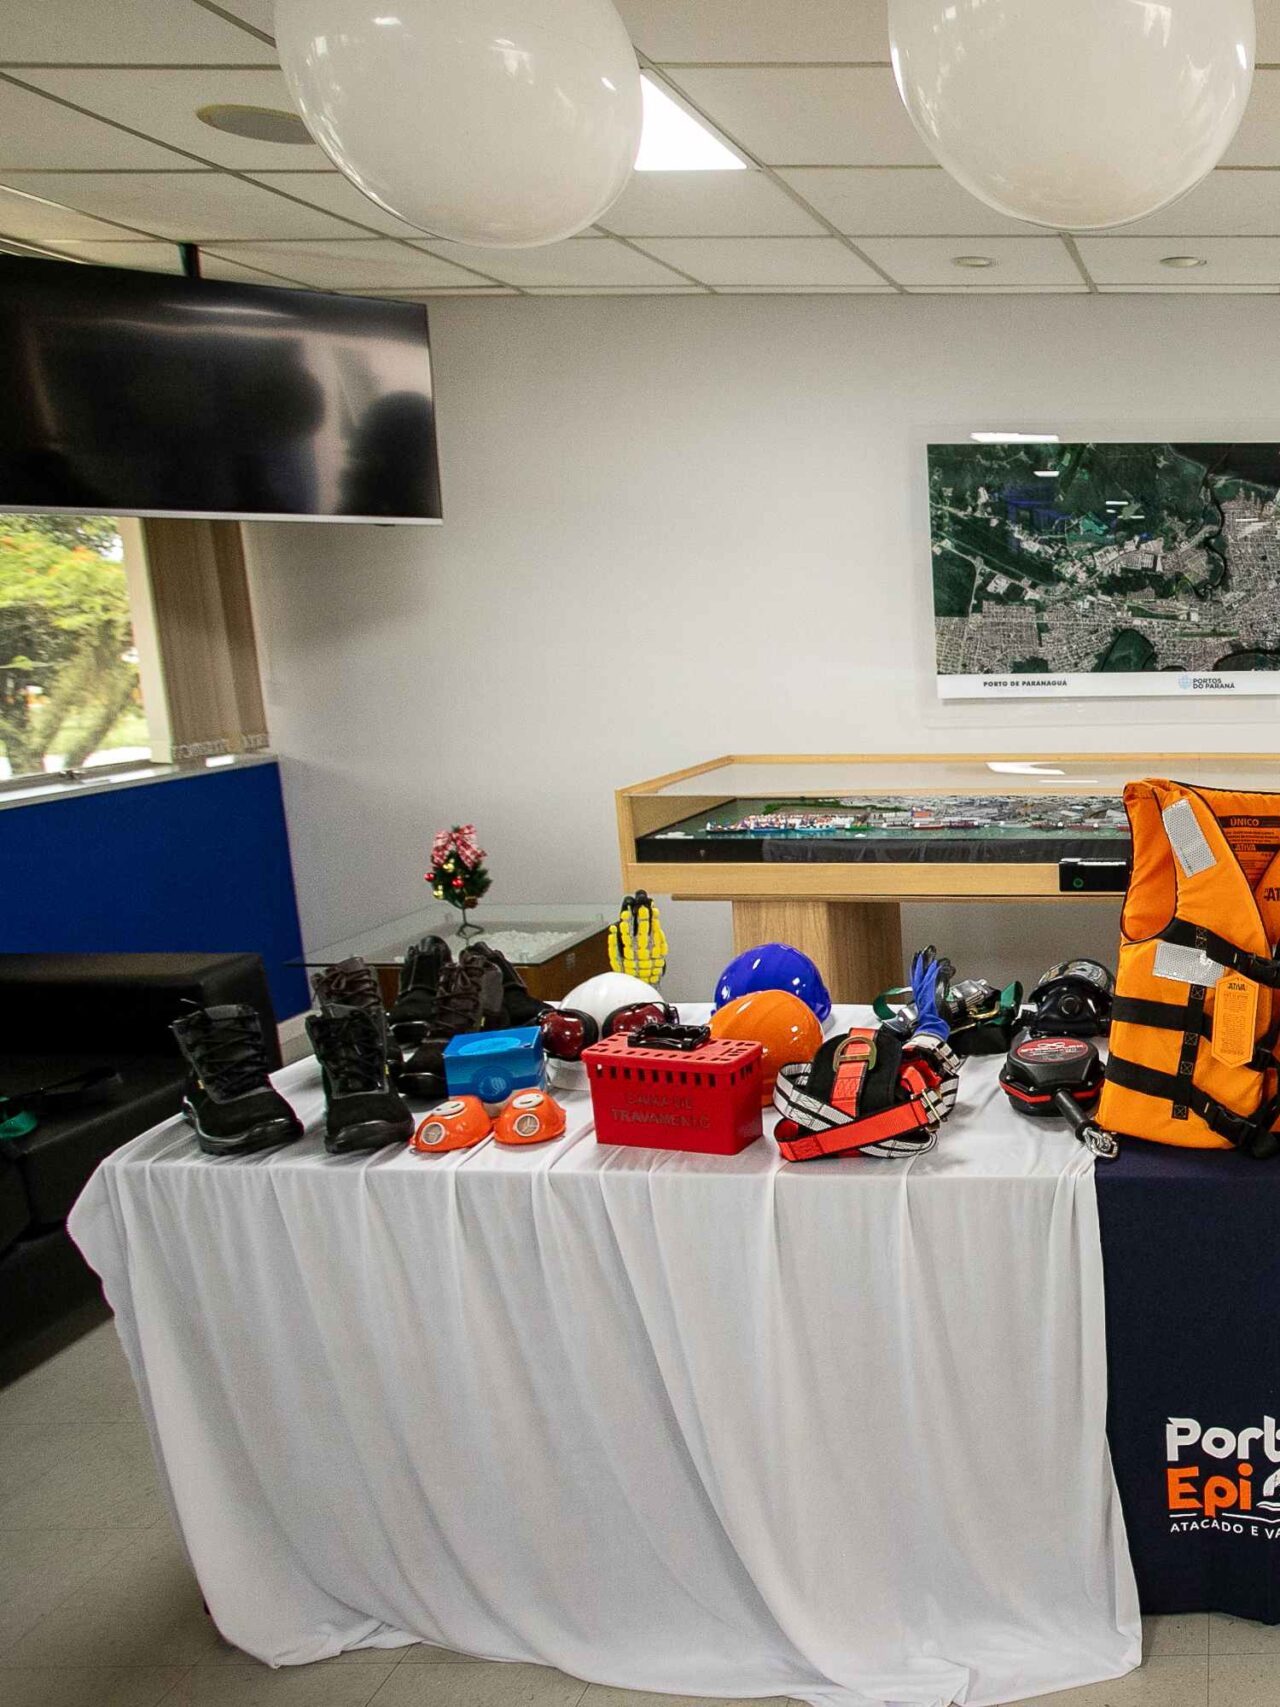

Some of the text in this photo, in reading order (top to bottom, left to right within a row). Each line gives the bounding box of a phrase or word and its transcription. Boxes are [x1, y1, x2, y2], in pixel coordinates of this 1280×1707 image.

[1230, 816, 1260, 827] ÚNICO
[1167, 1462, 1254, 1518] Epi
[1170, 1519, 1244, 1534] ATACADO
[1251, 1526, 1259, 1536] E
